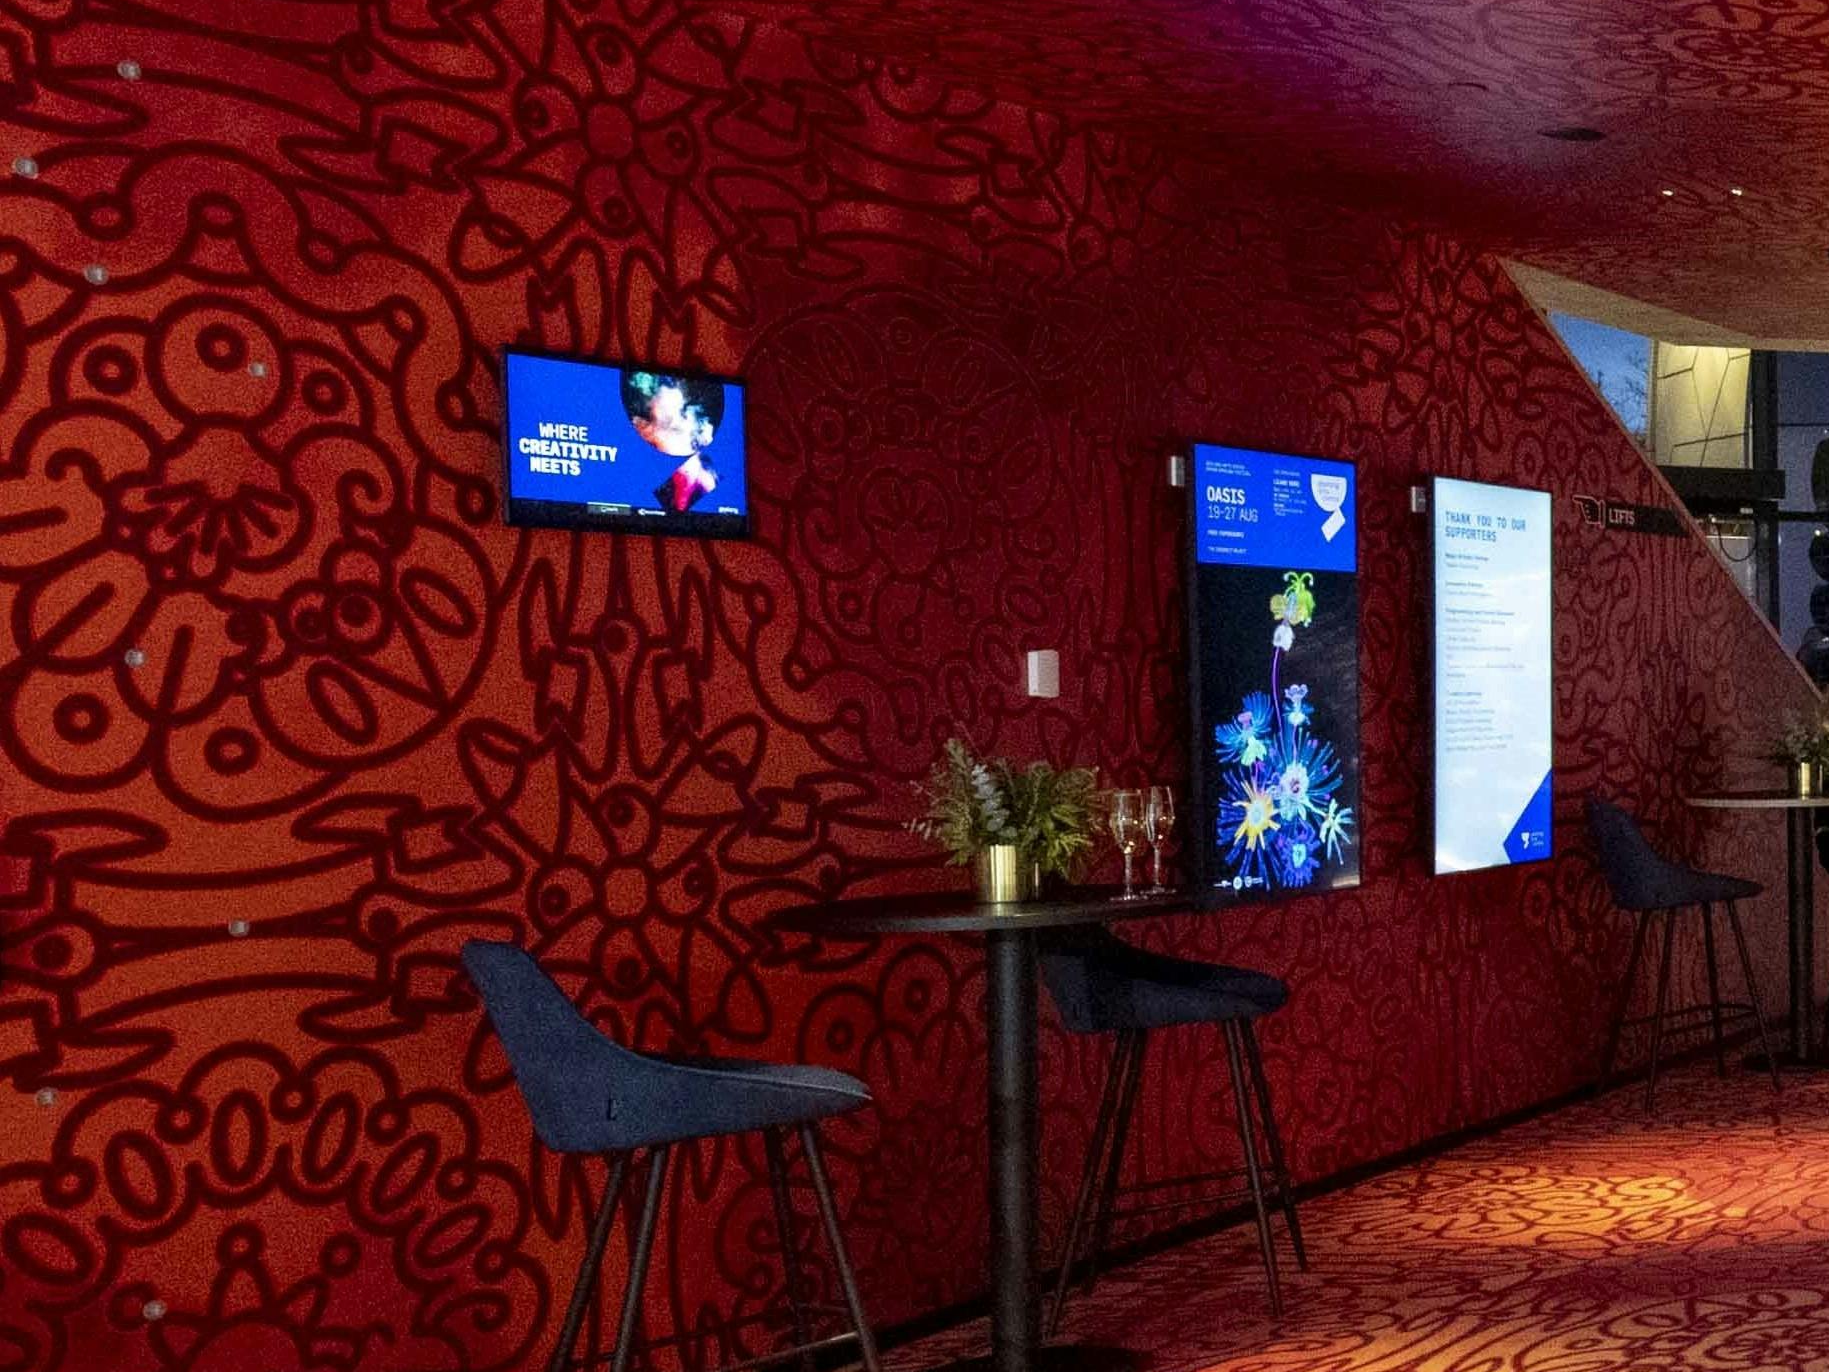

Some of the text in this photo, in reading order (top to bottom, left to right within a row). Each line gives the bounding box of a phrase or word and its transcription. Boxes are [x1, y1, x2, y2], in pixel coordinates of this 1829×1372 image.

[539, 422, 588, 442] WHERE
[519, 437, 617, 462] CREATIVITY
[530, 456, 581, 476] MEETS
[1206, 485, 1245, 505] OASIS
[1240, 507, 1258, 523] AUG
[1445, 510, 1471, 525] THANK
[1477, 514, 1492, 527] YOU
[1497, 516, 1507, 528] TO
[1608, 508, 1635, 524] LIFTS
[1445, 525, 1497, 542] SUPPORTERS
